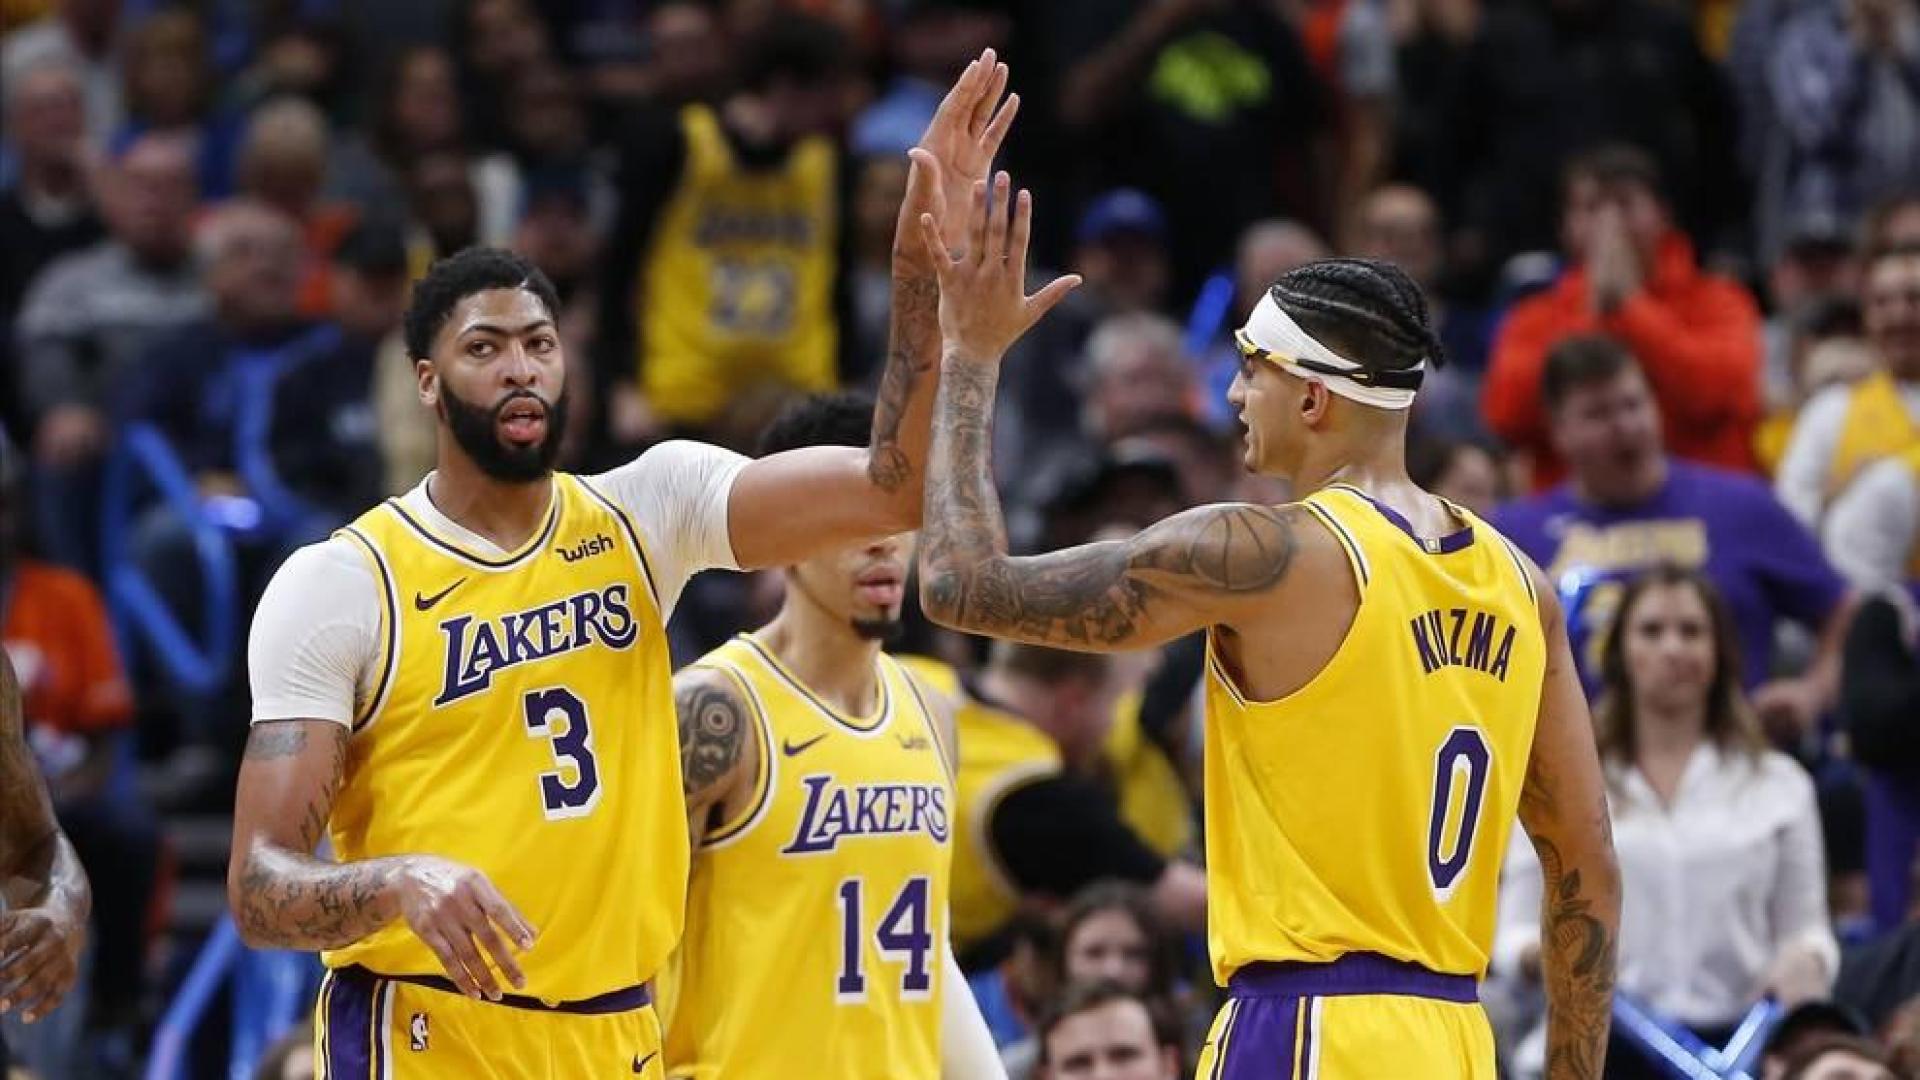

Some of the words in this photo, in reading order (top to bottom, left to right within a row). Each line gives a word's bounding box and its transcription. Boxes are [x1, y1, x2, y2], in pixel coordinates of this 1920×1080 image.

[556, 533, 614, 562] wish
[434, 583, 638, 707] LAKERS
[1410, 608, 1517, 683] KUZMA
[523, 686, 600, 818] 3
[1428, 727, 1491, 898] 0
[781, 774, 949, 855] LAKERS
[837, 877, 933, 1003] 14
